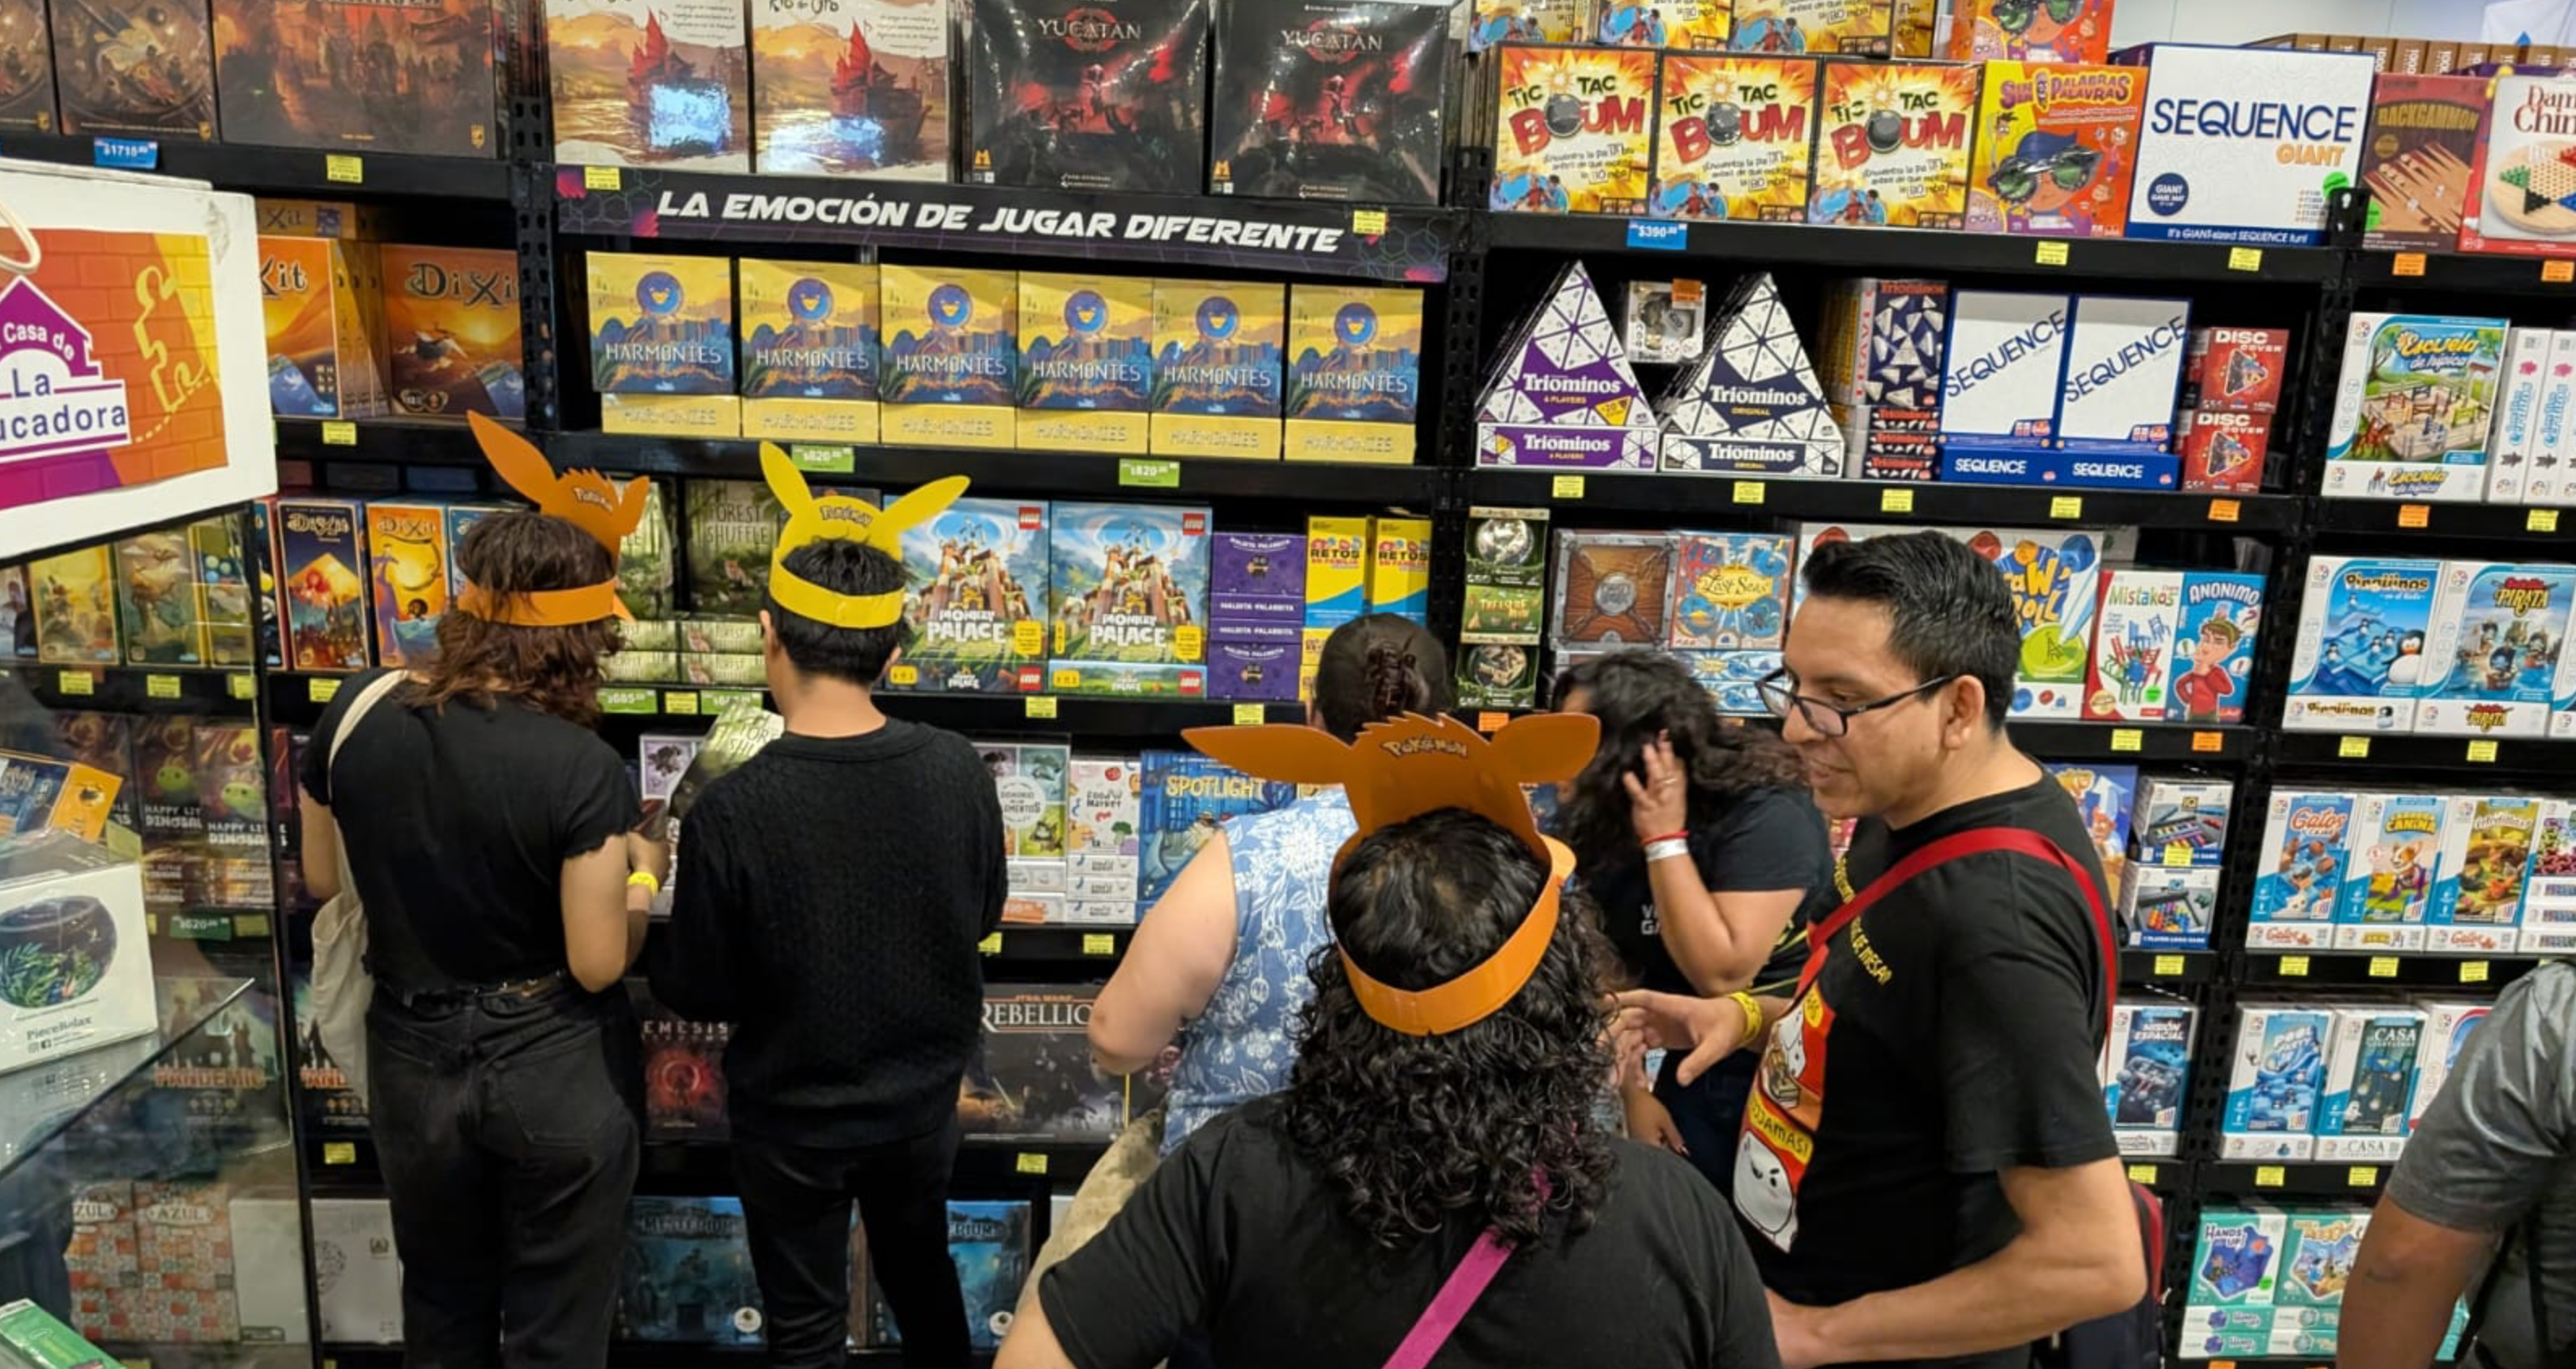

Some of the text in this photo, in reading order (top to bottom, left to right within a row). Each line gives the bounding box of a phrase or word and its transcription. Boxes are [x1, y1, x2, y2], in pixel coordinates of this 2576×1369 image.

[1039, 18, 1141, 40] YUCATAN
[1281, 29, 1383, 51] YUCATAN
[1577, 75, 1616, 94] TAC
[1738, 84, 1777, 103] TAC
[1508, 85, 1544, 108] TIC
[1670, 93, 1704, 116] TIC
[1900, 92, 1938, 109] TAC
[2527, 86, 2576, 108] Dam
[1508, 94, 1646, 157] BOUM
[2151, 98, 2356, 143] SEQUENCE
[2378, 101, 2480, 131] BACKGAMMON
[2514, 105, 2576, 134] Chin
[1670, 102, 1806, 164] BOUM
[1830, 110, 1966, 170] BOUM
[2275, 143, 2346, 165] GIANT
[2156, 184, 2183, 194] GIANT
[657, 190, 710, 218] LA
[722, 193, 911, 228] EMOCIÓN
[915, 203, 974, 231] DE
[979, 207, 1115, 239] JUGAR
[1124, 214, 1345, 253] DIFERENTE
[2237, 230, 2288, 242] SEQUENCE
[2, 322, 48, 344] Casa
[2215, 330, 2269, 344] DISC
[605, 343, 722, 364] HARMONIES
[756, 350, 869, 371] HARMONIES
[1944, 310, 2066, 399] SEQUENCE
[2063, 314, 2186, 403] SEQUENCE
[896, 355, 1008, 376] HARMONIES
[1032, 360, 1141, 383] HARMONIES
[12, 368, 51, 399] La
[1163, 367, 1272, 388] HARMONIES
[1300, 372, 1408, 394] HARMONIES
[1523, 373, 1623, 394] Triominos
[1709, 385, 1807, 406] Triominos
[2197, 412, 2251, 427] DISC
[1523, 434, 1611, 452] Triominos
[1708, 443, 1796, 463] Triominos
[1955, 458, 2027, 475] SEQUENCE
[2073, 463, 2143, 480] SEQUENCE
[705, 523, 770, 544] SHUFFLE
[1311, 548, 1360, 559] RETOS
[1378, 550, 1430, 561] RETOS
[2189, 582, 2261, 606] ANONIMO
[2494, 587, 2549, 617] PIRATA
[939, 609, 996, 628] MONKEY
[1102, 613, 1158, 628] MONKEY
[927, 621, 1008, 644] PALACE
[1089, 625, 1168, 648] PALACE
[1165, 774, 1265, 799] SPOTLIGHT
[207, 822, 245, 834] HAPPY
[2291, 808, 2349, 832] Gatos
[643, 1020, 729, 1035] EMESIS
[981, 1001, 1094, 1034] REBELLIO
[2373, 1027, 2418, 1043] CASA
[75, 1204, 106, 1218] ZUL
